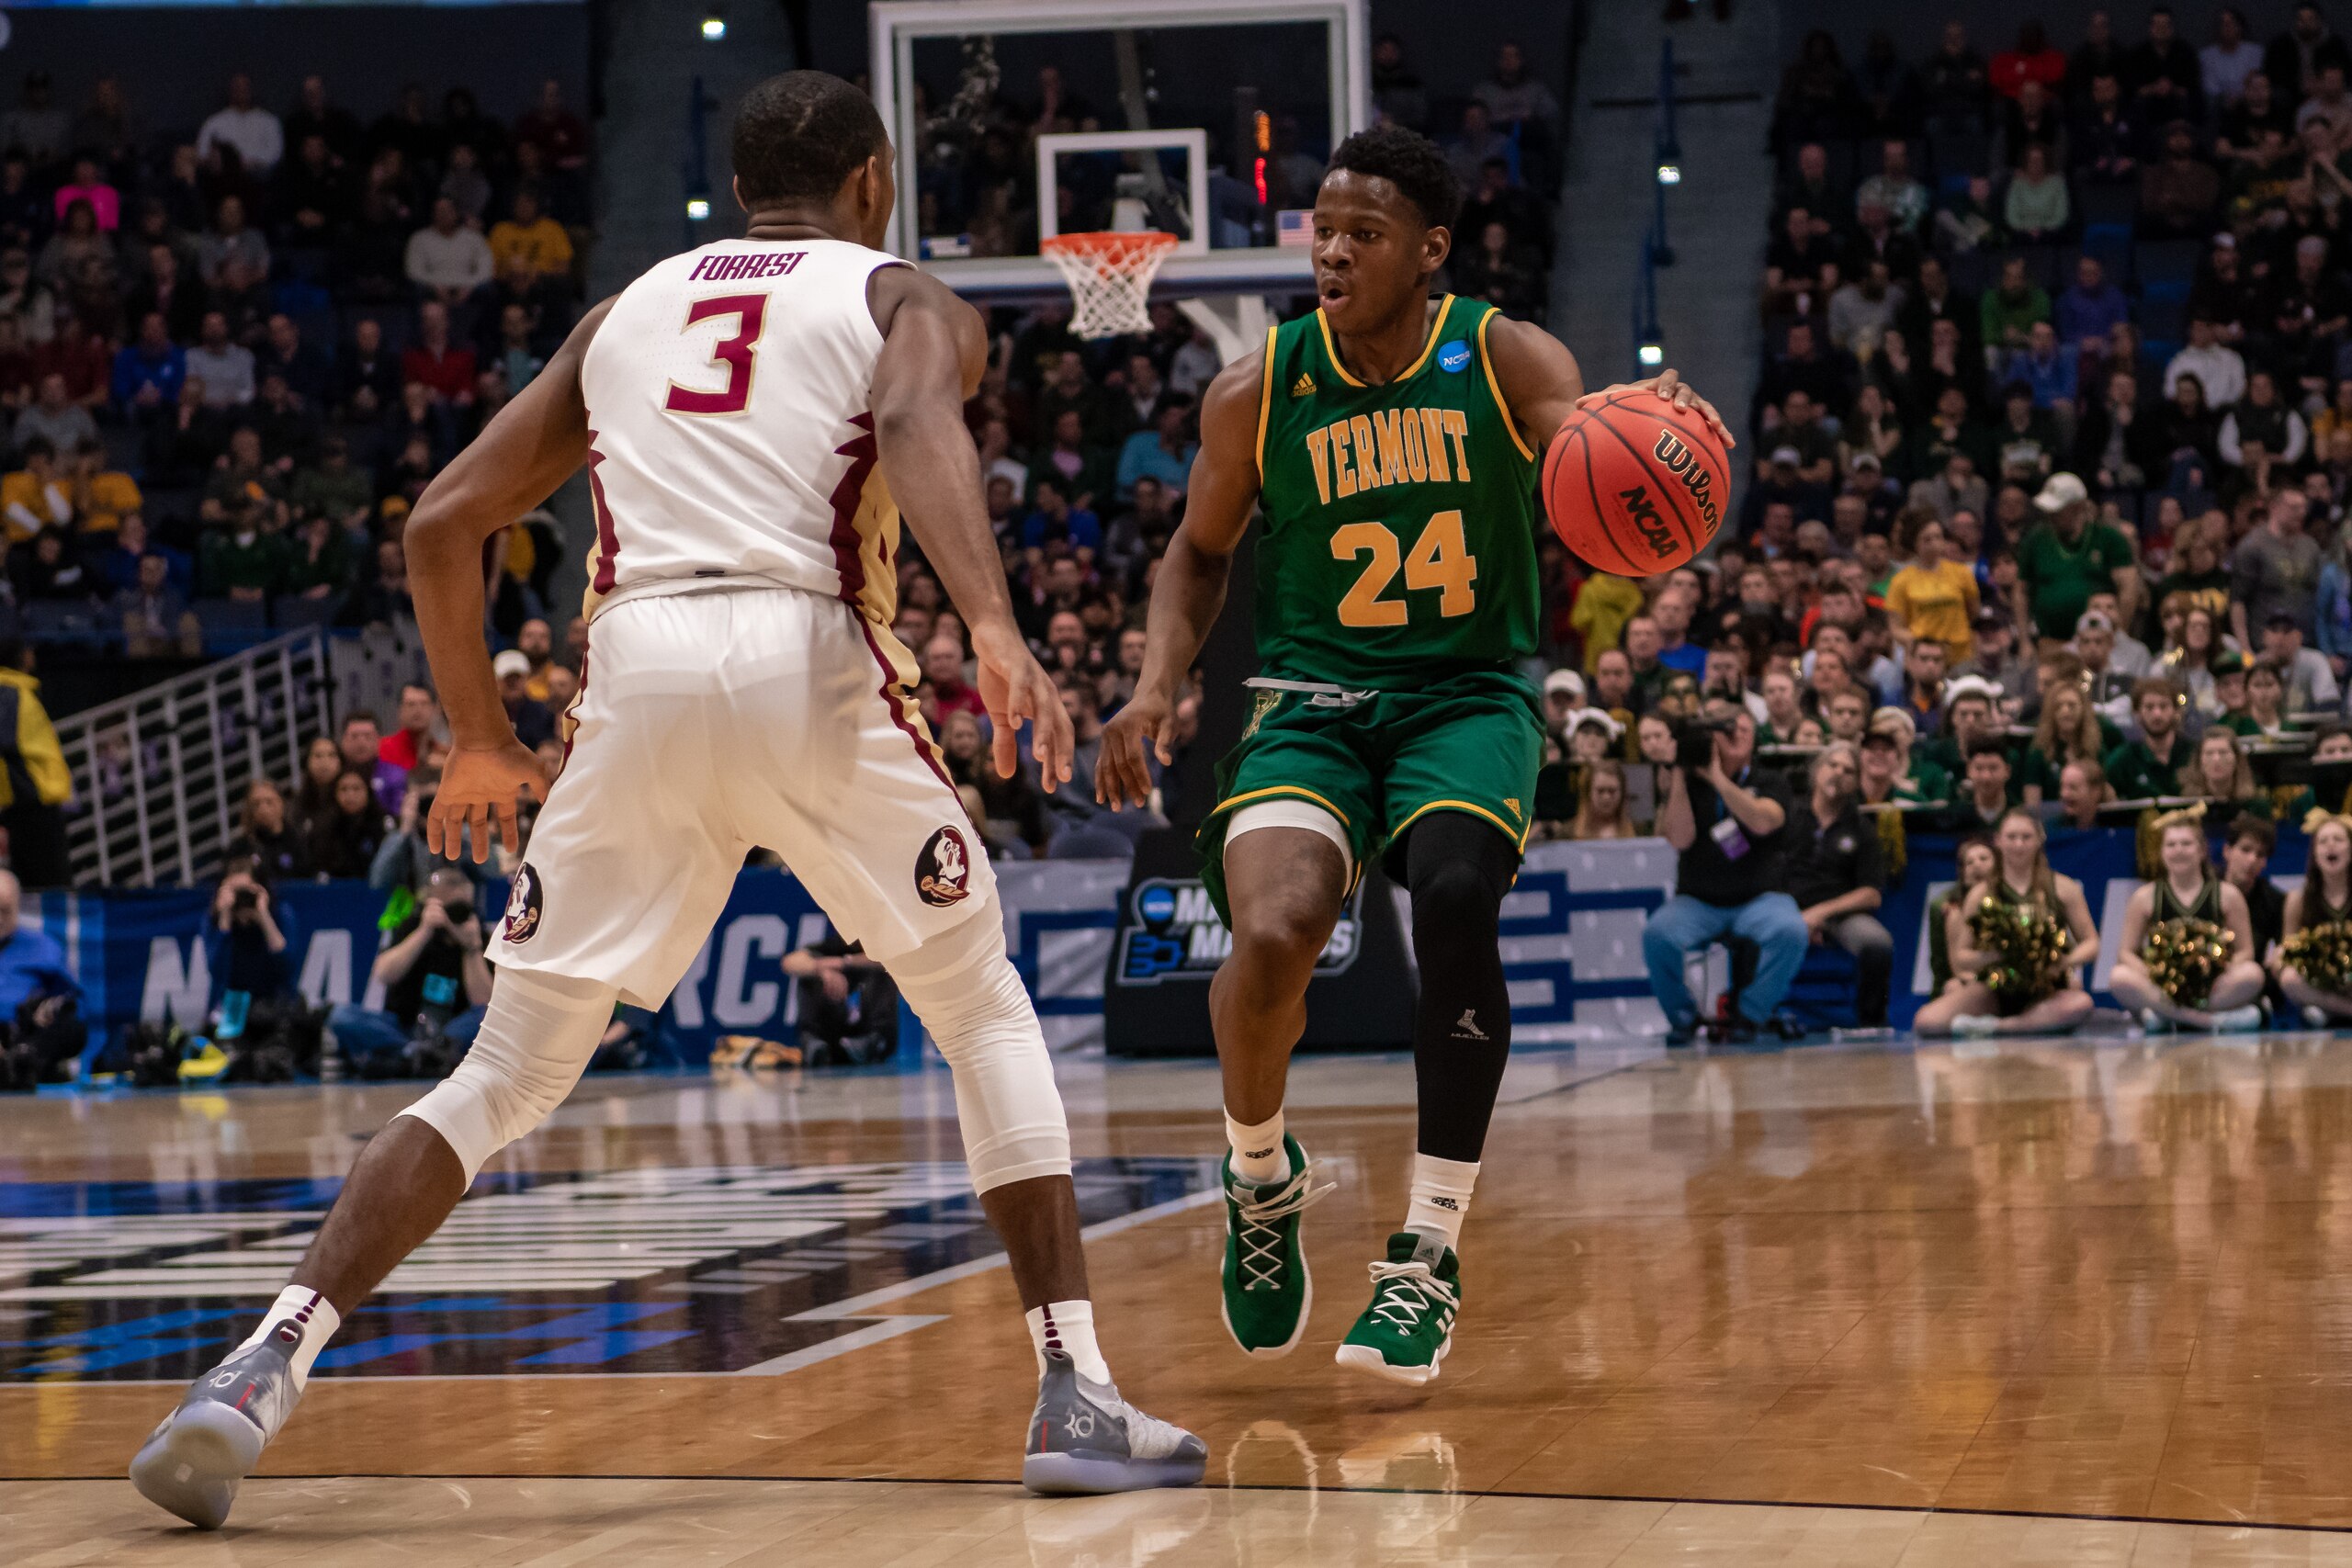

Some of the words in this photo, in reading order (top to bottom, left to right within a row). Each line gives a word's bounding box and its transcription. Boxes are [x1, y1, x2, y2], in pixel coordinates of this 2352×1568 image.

[688, 252, 808, 281] FORREST
[661, 291, 773, 418] 3
[1306, 408, 1471, 505] VERMONT
[1654, 428, 1719, 538] Wilson
[1329, 509, 1477, 627] 24
[1620, 485, 1681, 559] NCAA
